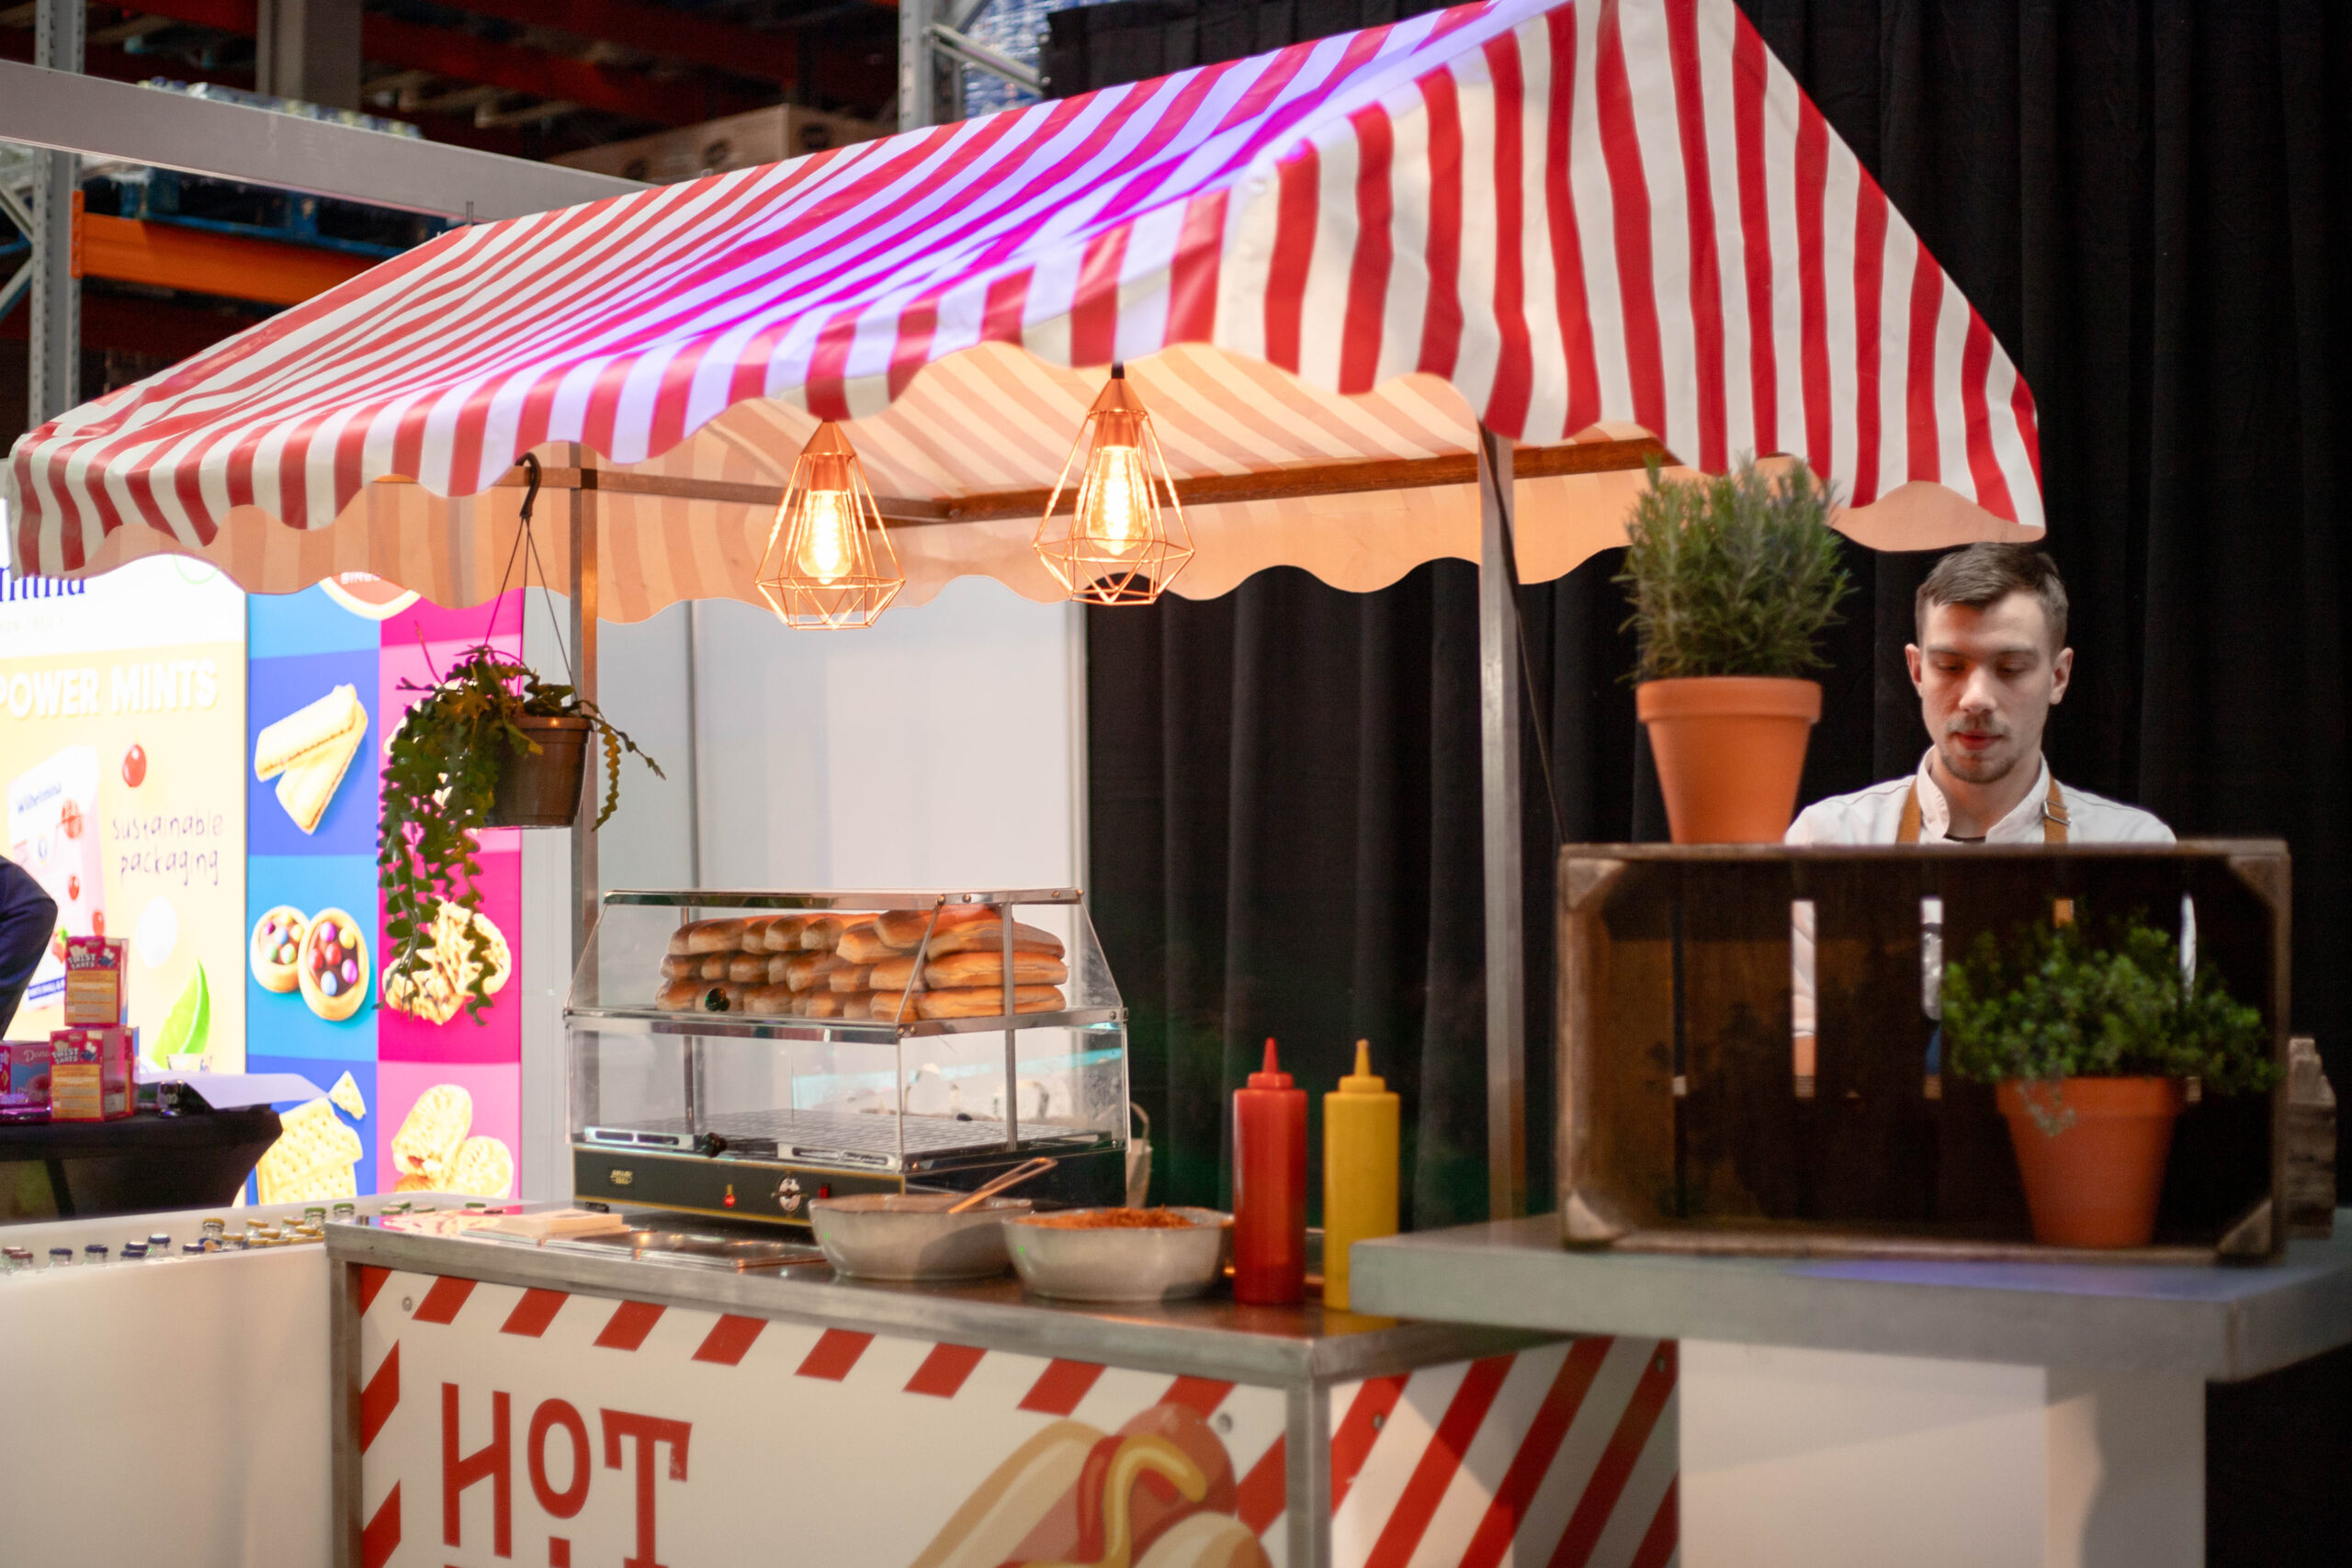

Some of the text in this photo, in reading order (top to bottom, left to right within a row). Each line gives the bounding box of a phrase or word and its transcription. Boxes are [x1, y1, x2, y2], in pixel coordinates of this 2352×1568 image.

[111, 658, 217, 715] MINTS
[111, 807, 223, 840] sustainable
[120, 845, 219, 888] packaging
[441, 1382, 693, 1564] HOT
